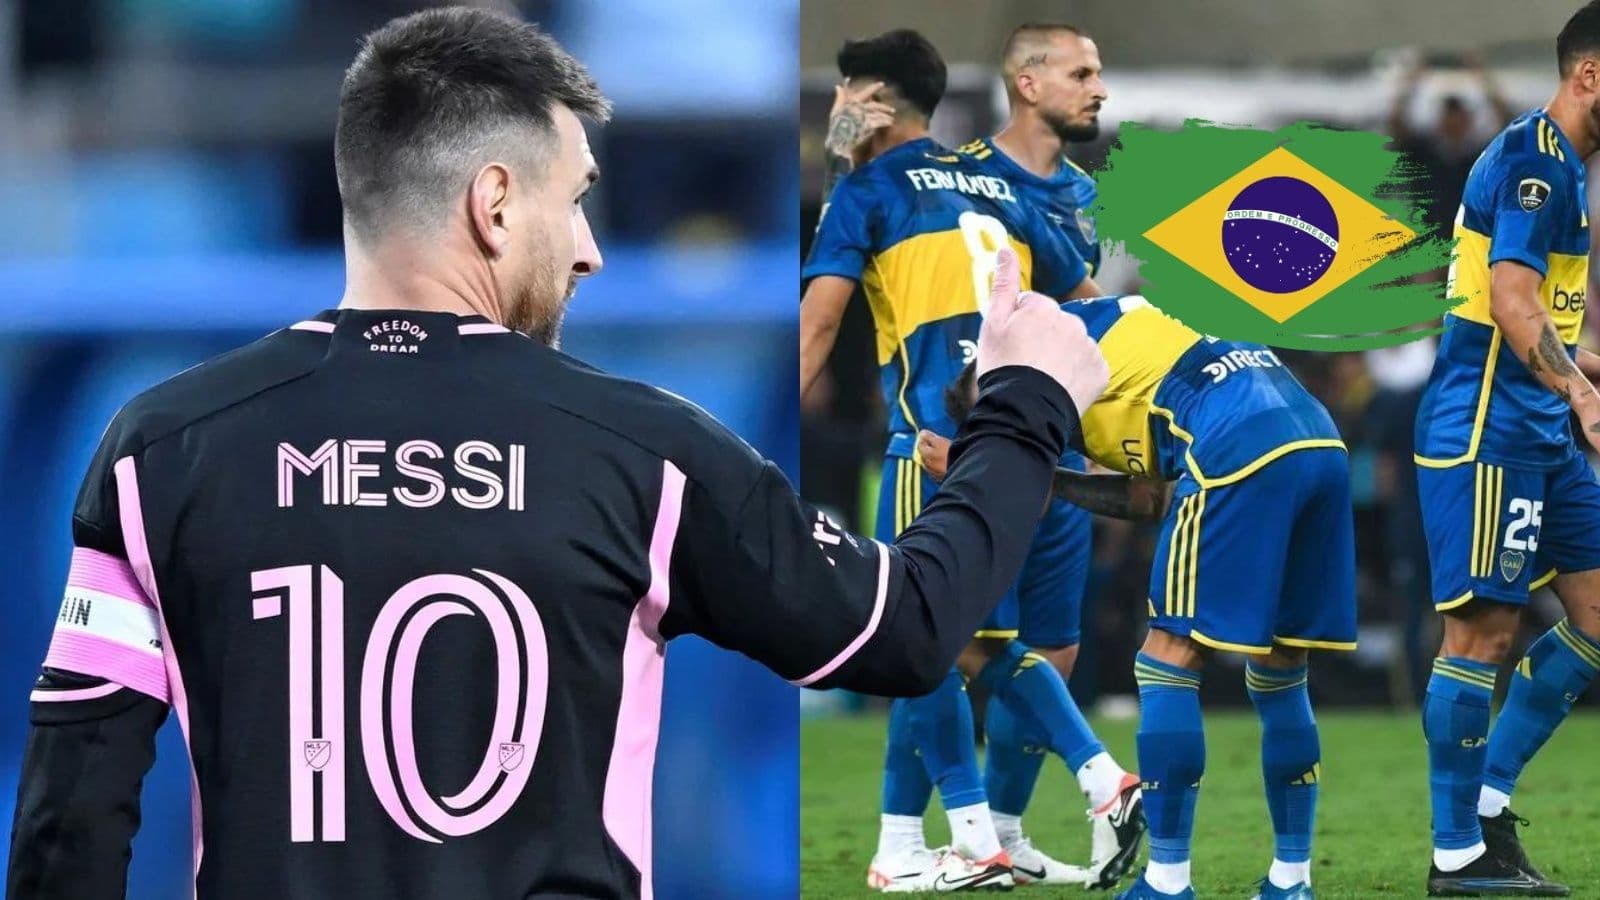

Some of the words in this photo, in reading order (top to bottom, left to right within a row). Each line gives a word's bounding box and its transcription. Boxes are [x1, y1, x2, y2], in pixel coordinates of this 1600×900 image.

[363, 320, 428, 341] FREEDOM
[370, 344, 418, 353] DREAM
[388, 335, 403, 343] TO
[277, 438, 526, 512] MESSI
[1503, 497, 1543, 552] 25
[251, 564, 549, 844] 10
